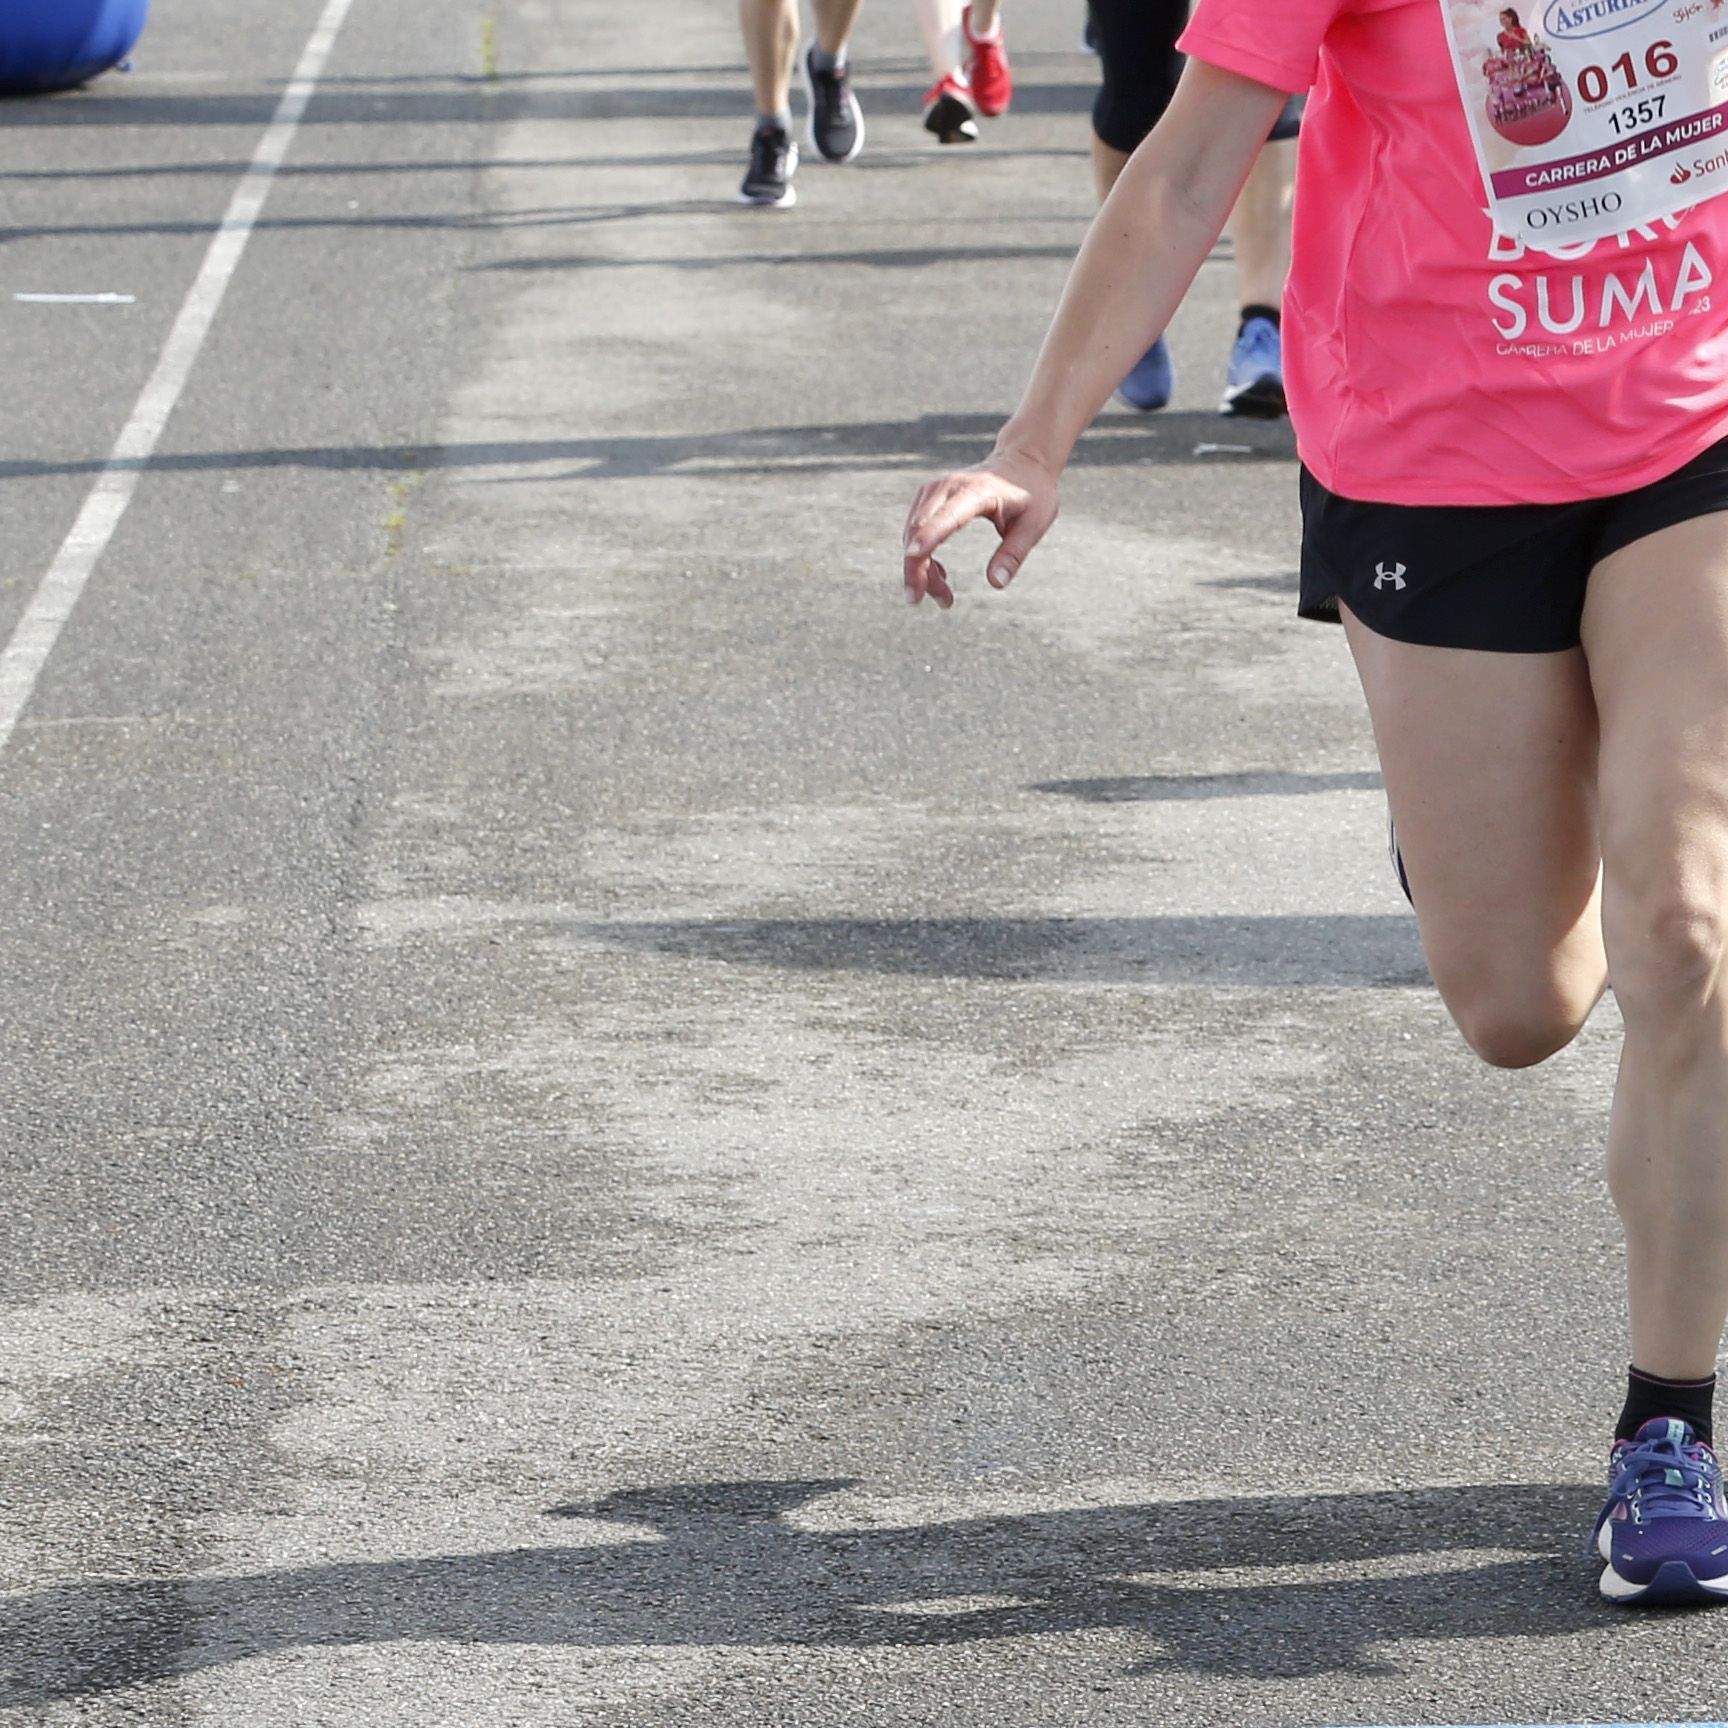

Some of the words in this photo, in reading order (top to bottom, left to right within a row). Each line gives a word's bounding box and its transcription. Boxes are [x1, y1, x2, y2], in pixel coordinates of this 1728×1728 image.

[1576, 39, 1680, 104] 016
[1607, 94, 1668, 136] 1357
[1525, 151, 1612, 189] CARRERA
[1614, 144, 1638, 163] DE
[1639, 135, 1663, 155] LA
[1665, 111, 1724, 148] MUJER
[1525, 190, 1623, 231] OYSHO
[1487, 240, 1714, 341] SUMA
[1571, 340, 1594, 356] DE
[1595, 334, 1618, 353] LA
[1618, 319, 1675, 343] MUJER
